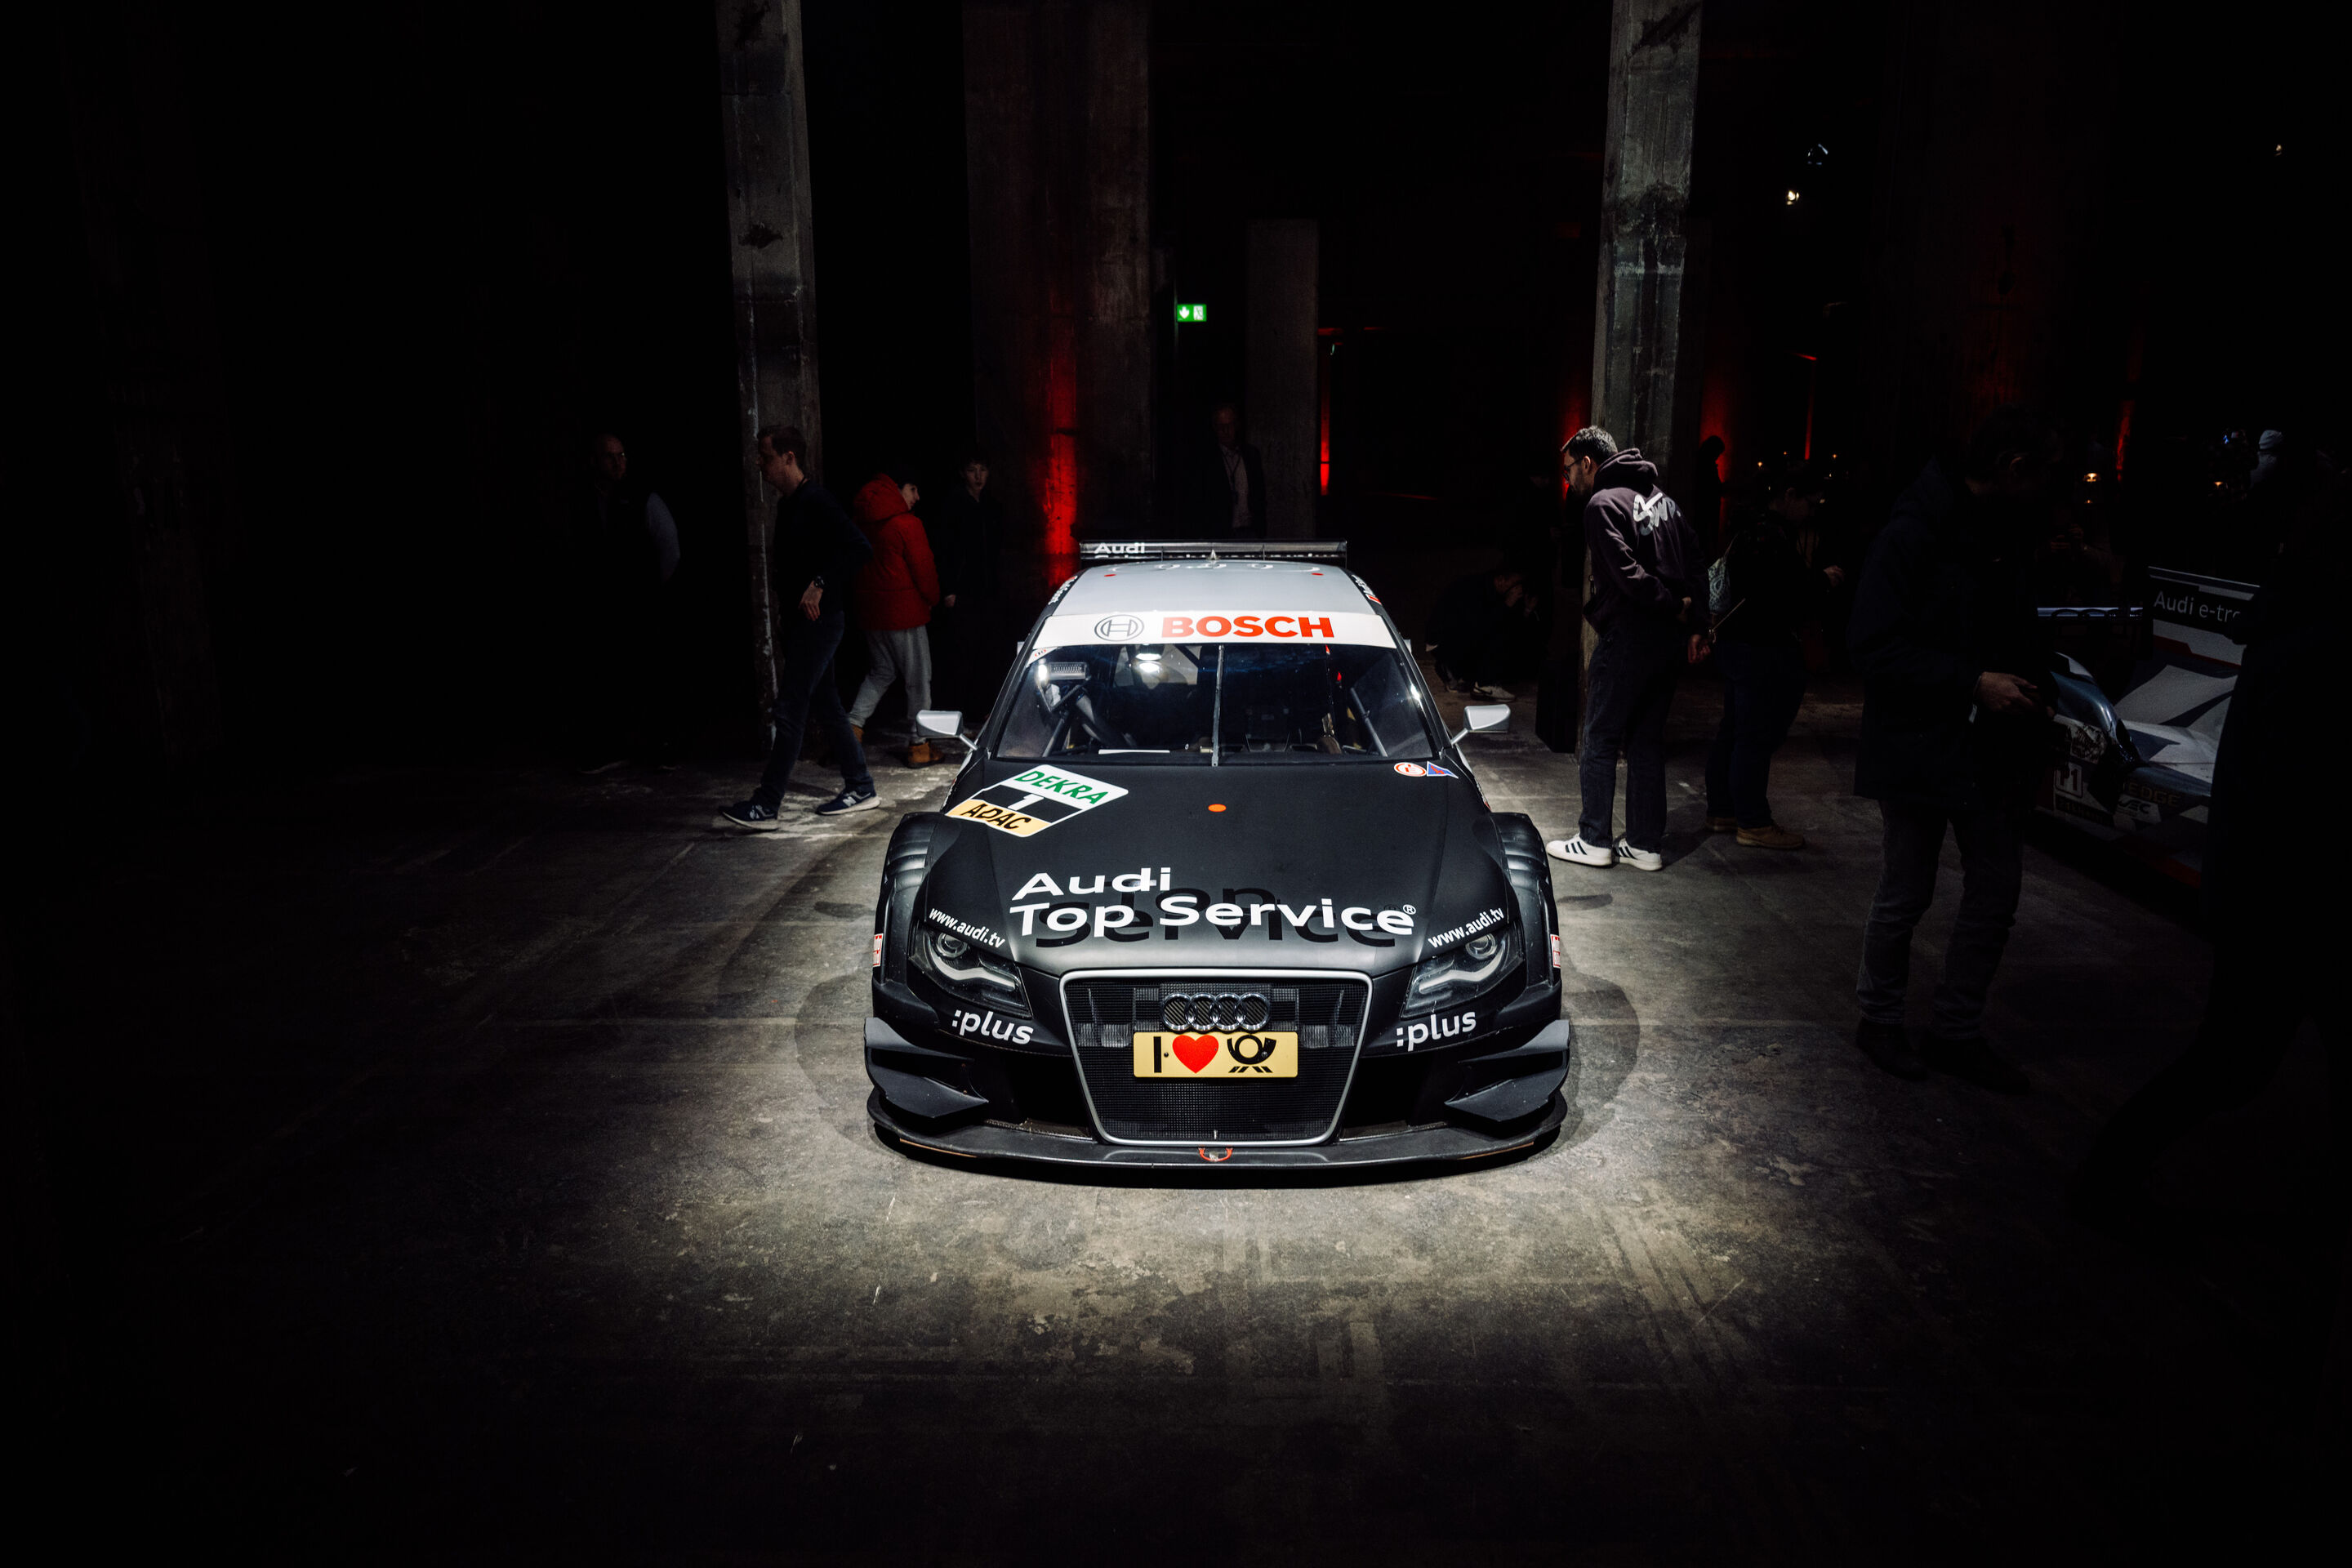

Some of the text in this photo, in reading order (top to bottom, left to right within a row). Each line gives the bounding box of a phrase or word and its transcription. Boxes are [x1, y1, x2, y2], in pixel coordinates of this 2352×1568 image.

[1094, 542, 1145, 555] Audi
[2153, 589, 2195, 616] Audi
[1161, 615, 1334, 639] BOSCH
[1007, 793, 1045, 811] 1
[1013, 770, 1109, 804] DEKRA
[960, 803, 1032, 830] ADAC
[1011, 866, 1171, 901] Audi
[929, 907, 1006, 949] www.audi.tv
[1009, 902, 1134, 938] Top
[1428, 906, 1504, 948] www.audi.tv
[951, 1009, 1035, 1045] :plus
[1396, 1011, 1477, 1052] :plus
